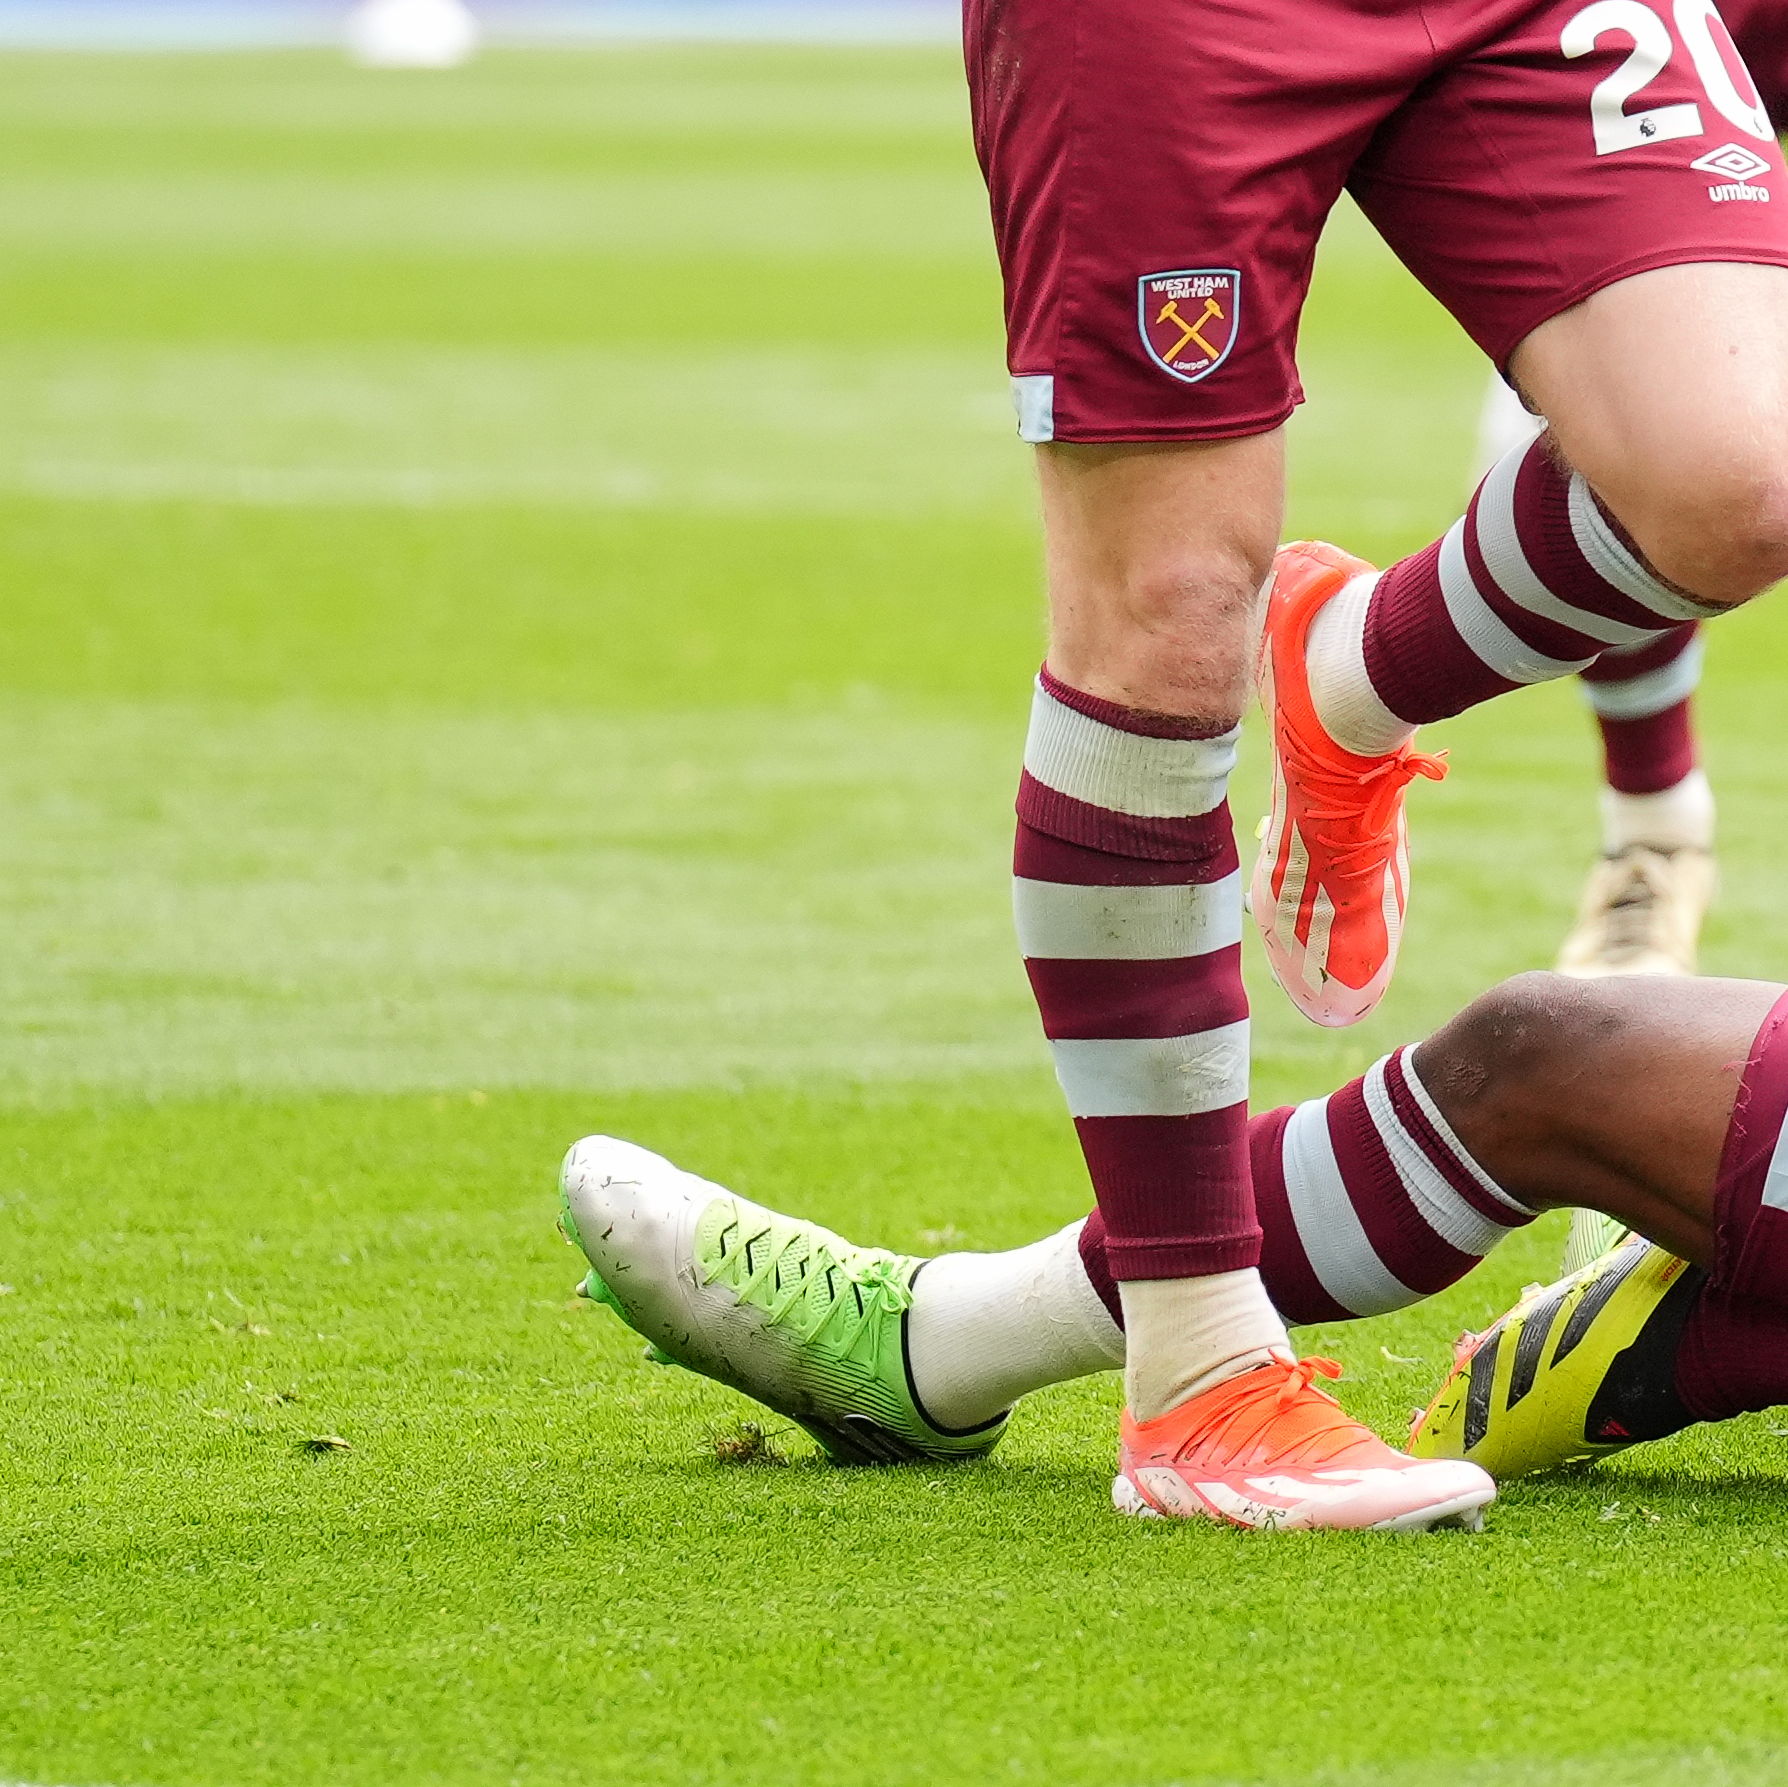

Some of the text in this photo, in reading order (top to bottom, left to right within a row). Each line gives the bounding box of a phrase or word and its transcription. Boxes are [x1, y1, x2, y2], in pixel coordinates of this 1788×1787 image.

[1708, 181, 1771, 203] umbro
[1151, 276, 1230, 292] WEST HAM
[1167, 286, 1214, 299] UNITED
[1172, 358, 1210, 371] LONDON
